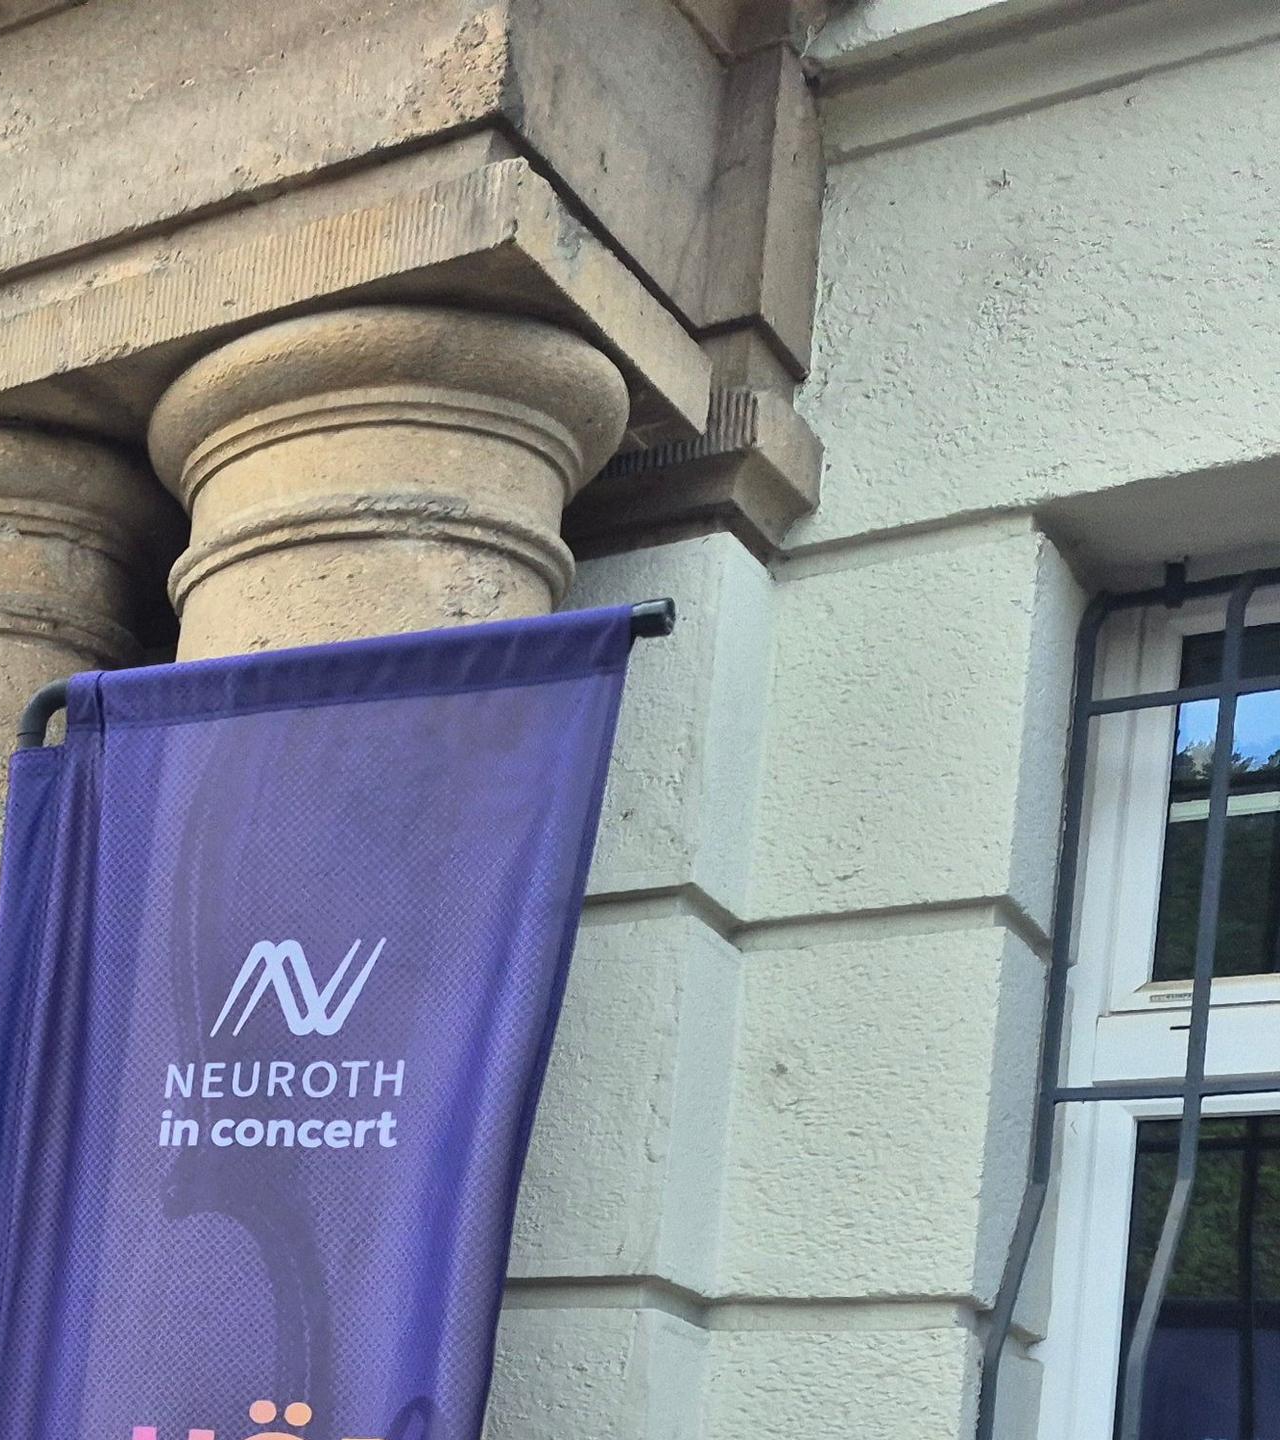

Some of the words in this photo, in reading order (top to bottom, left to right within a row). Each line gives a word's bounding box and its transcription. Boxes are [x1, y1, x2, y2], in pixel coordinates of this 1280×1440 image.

[163, 1059, 405, 1099] NEUROTH
[159, 1110, 199, 1147] in
[211, 1112, 398, 1148] concert
